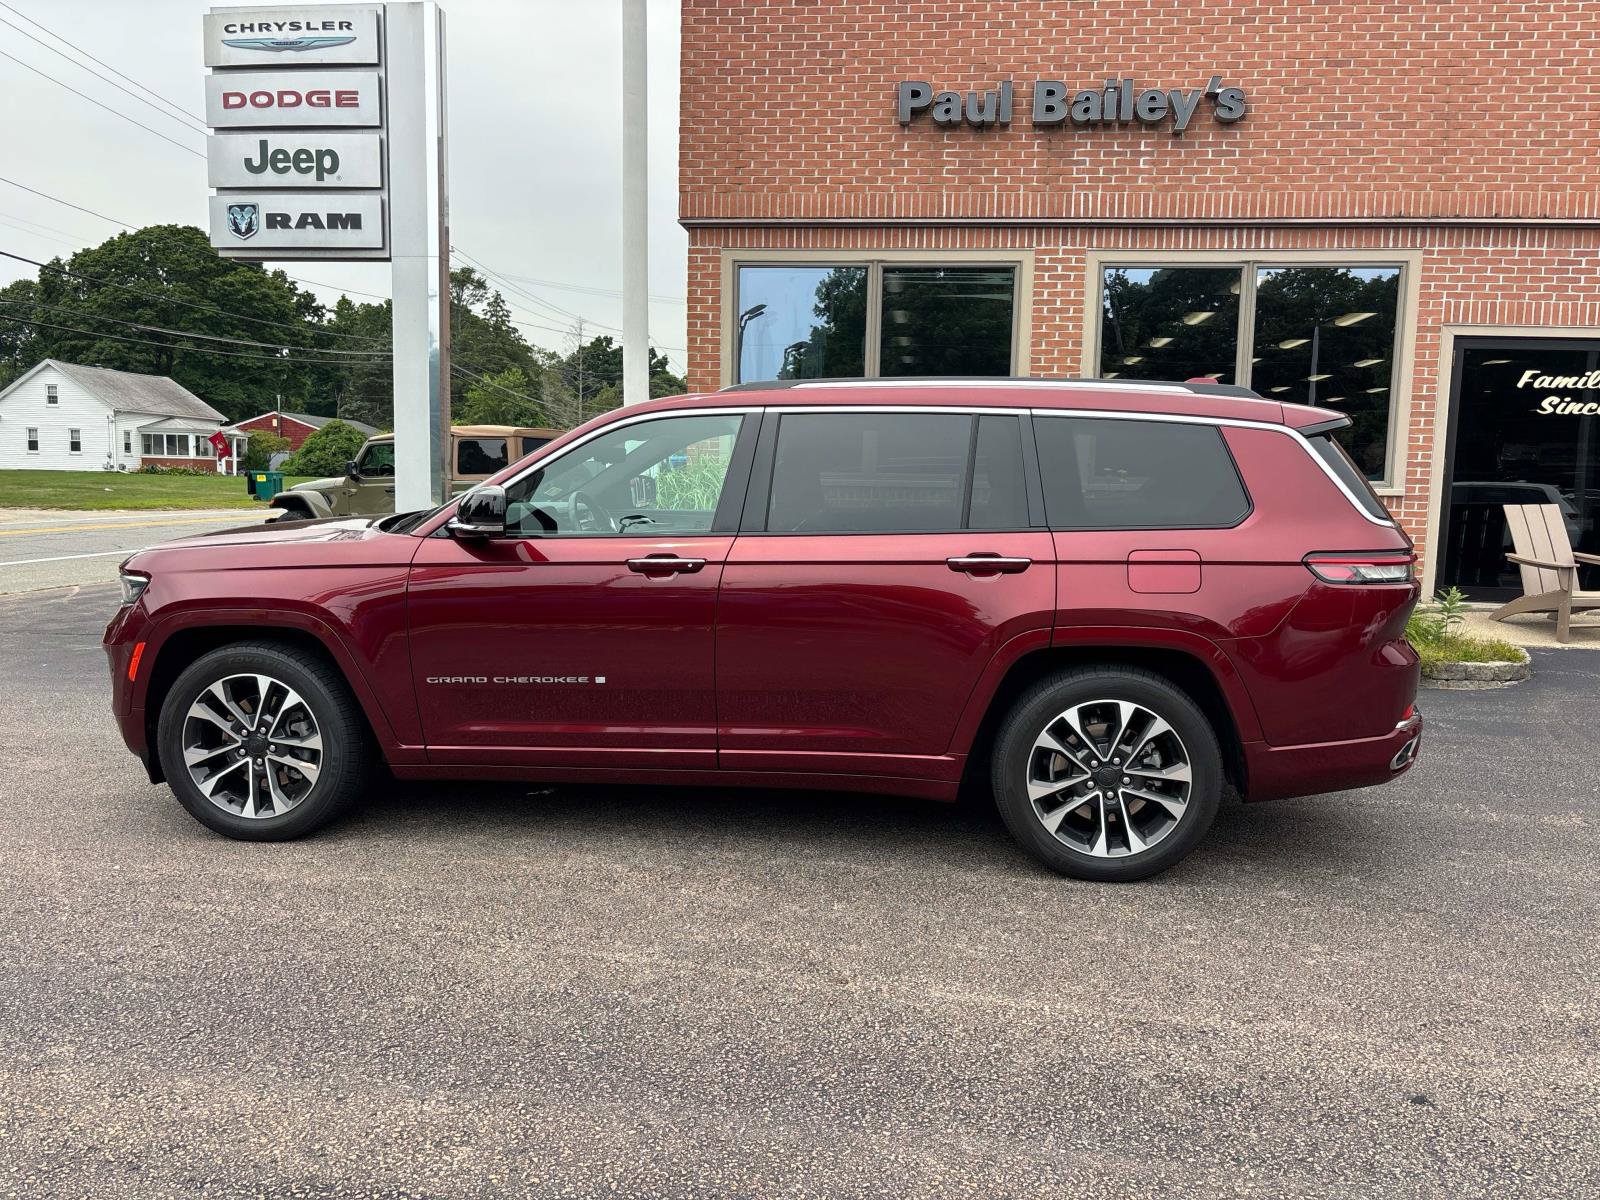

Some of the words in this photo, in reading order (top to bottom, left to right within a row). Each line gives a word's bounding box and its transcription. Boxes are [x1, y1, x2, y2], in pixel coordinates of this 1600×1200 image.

[223, 20, 353, 34] CHRYSLER
[222, 90, 360, 110] DODGE
[900, 80, 1012, 126] Paul
[1032, 75, 1246, 134] Bailey's
[243, 139, 340, 182] Jeep
[265, 212, 362, 230] RAM
[1516, 370, 1600, 389] Famil
[1536, 396, 1600, 416] Sinc
[426, 676, 488, 684] GRAND
[493, 676, 590, 684] CHEROKEE
